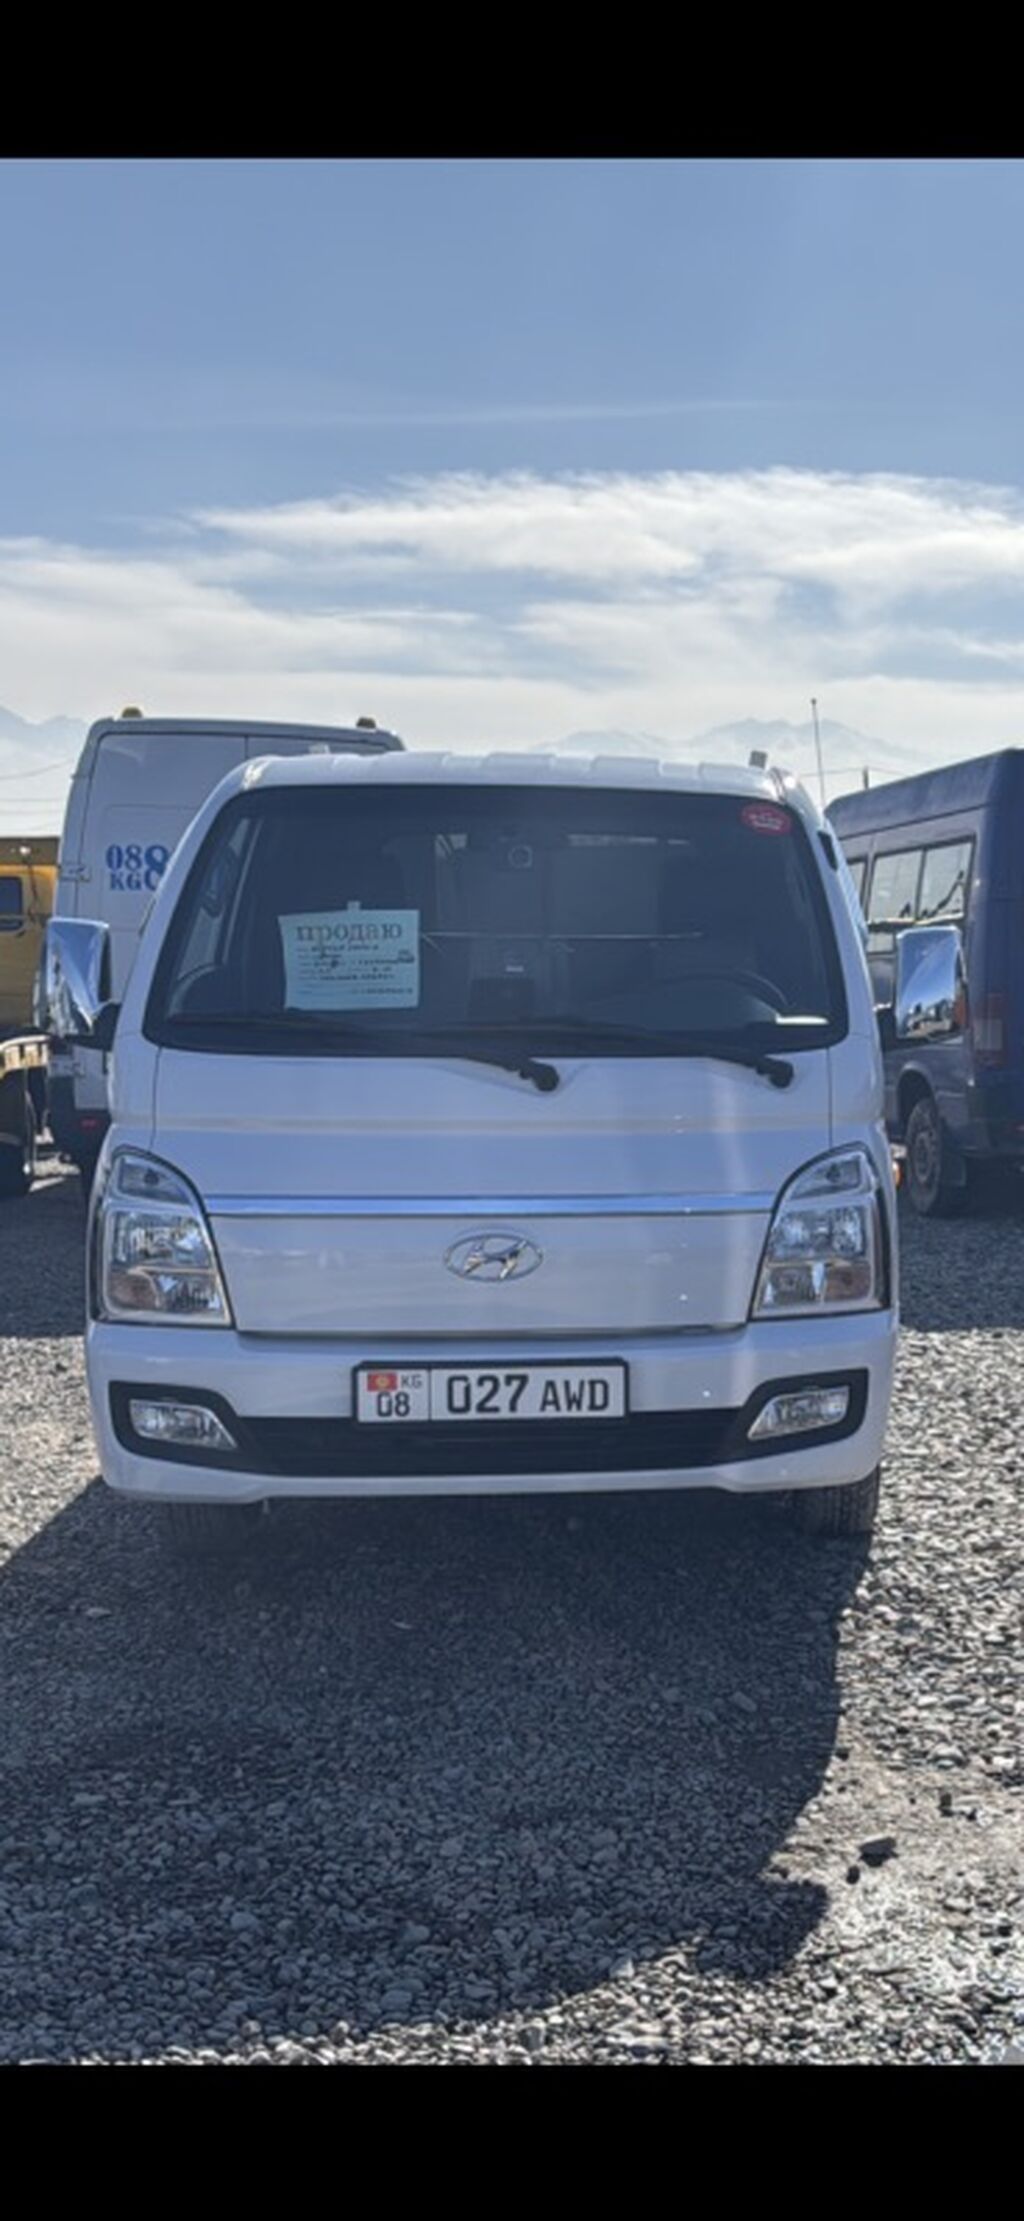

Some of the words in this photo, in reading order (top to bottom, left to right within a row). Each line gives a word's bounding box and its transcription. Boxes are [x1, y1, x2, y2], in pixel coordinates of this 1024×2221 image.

[109, 872, 142, 892] KG
[296, 922, 403, 944] продаю
[400, 1374, 423, 1389] KG
[375, 1391, 411, 1418] 08
[446, 1373, 529, 1414] 027
[539, 1379, 611, 1412] AWD
